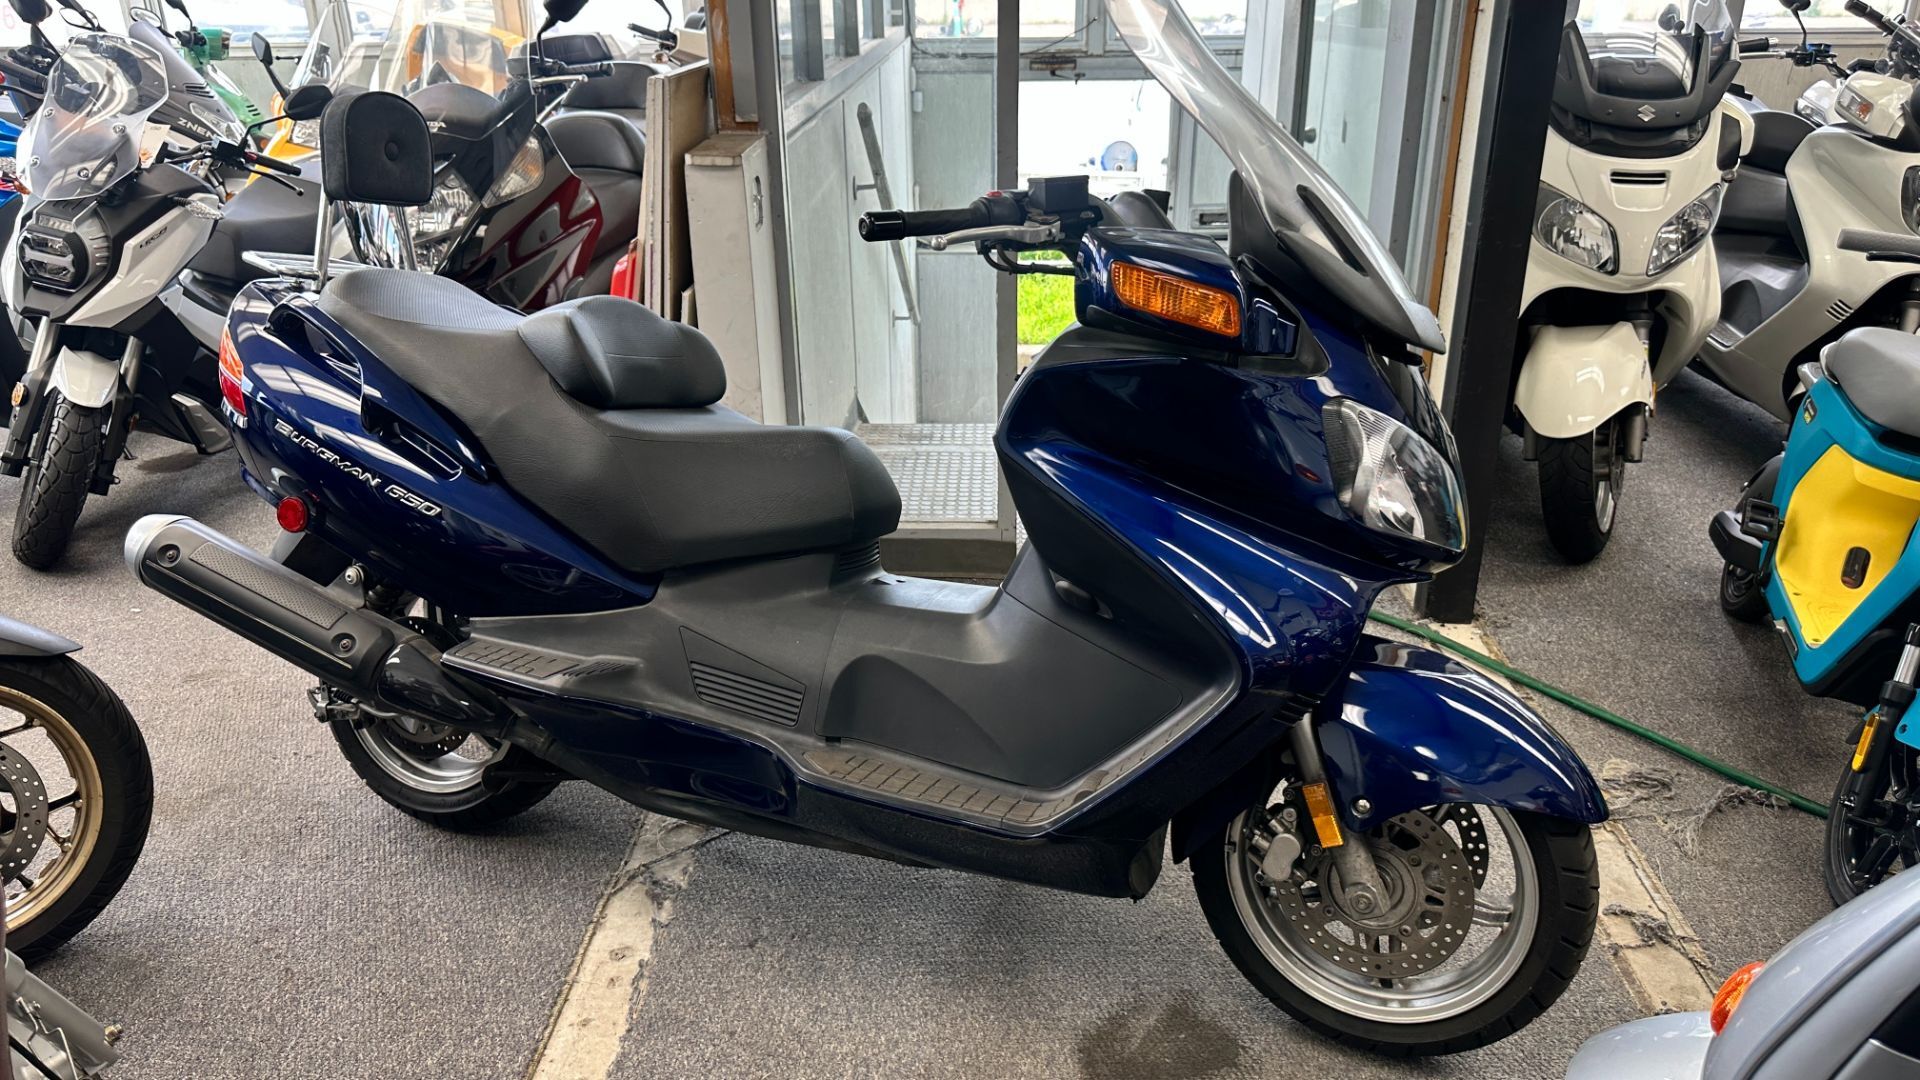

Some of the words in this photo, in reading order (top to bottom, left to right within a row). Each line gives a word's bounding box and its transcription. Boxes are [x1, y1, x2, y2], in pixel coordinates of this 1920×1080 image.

[177, 117, 217, 138] ZNEN
[274, 418, 382, 487] BURGMAN
[384, 484, 442, 516] 650
